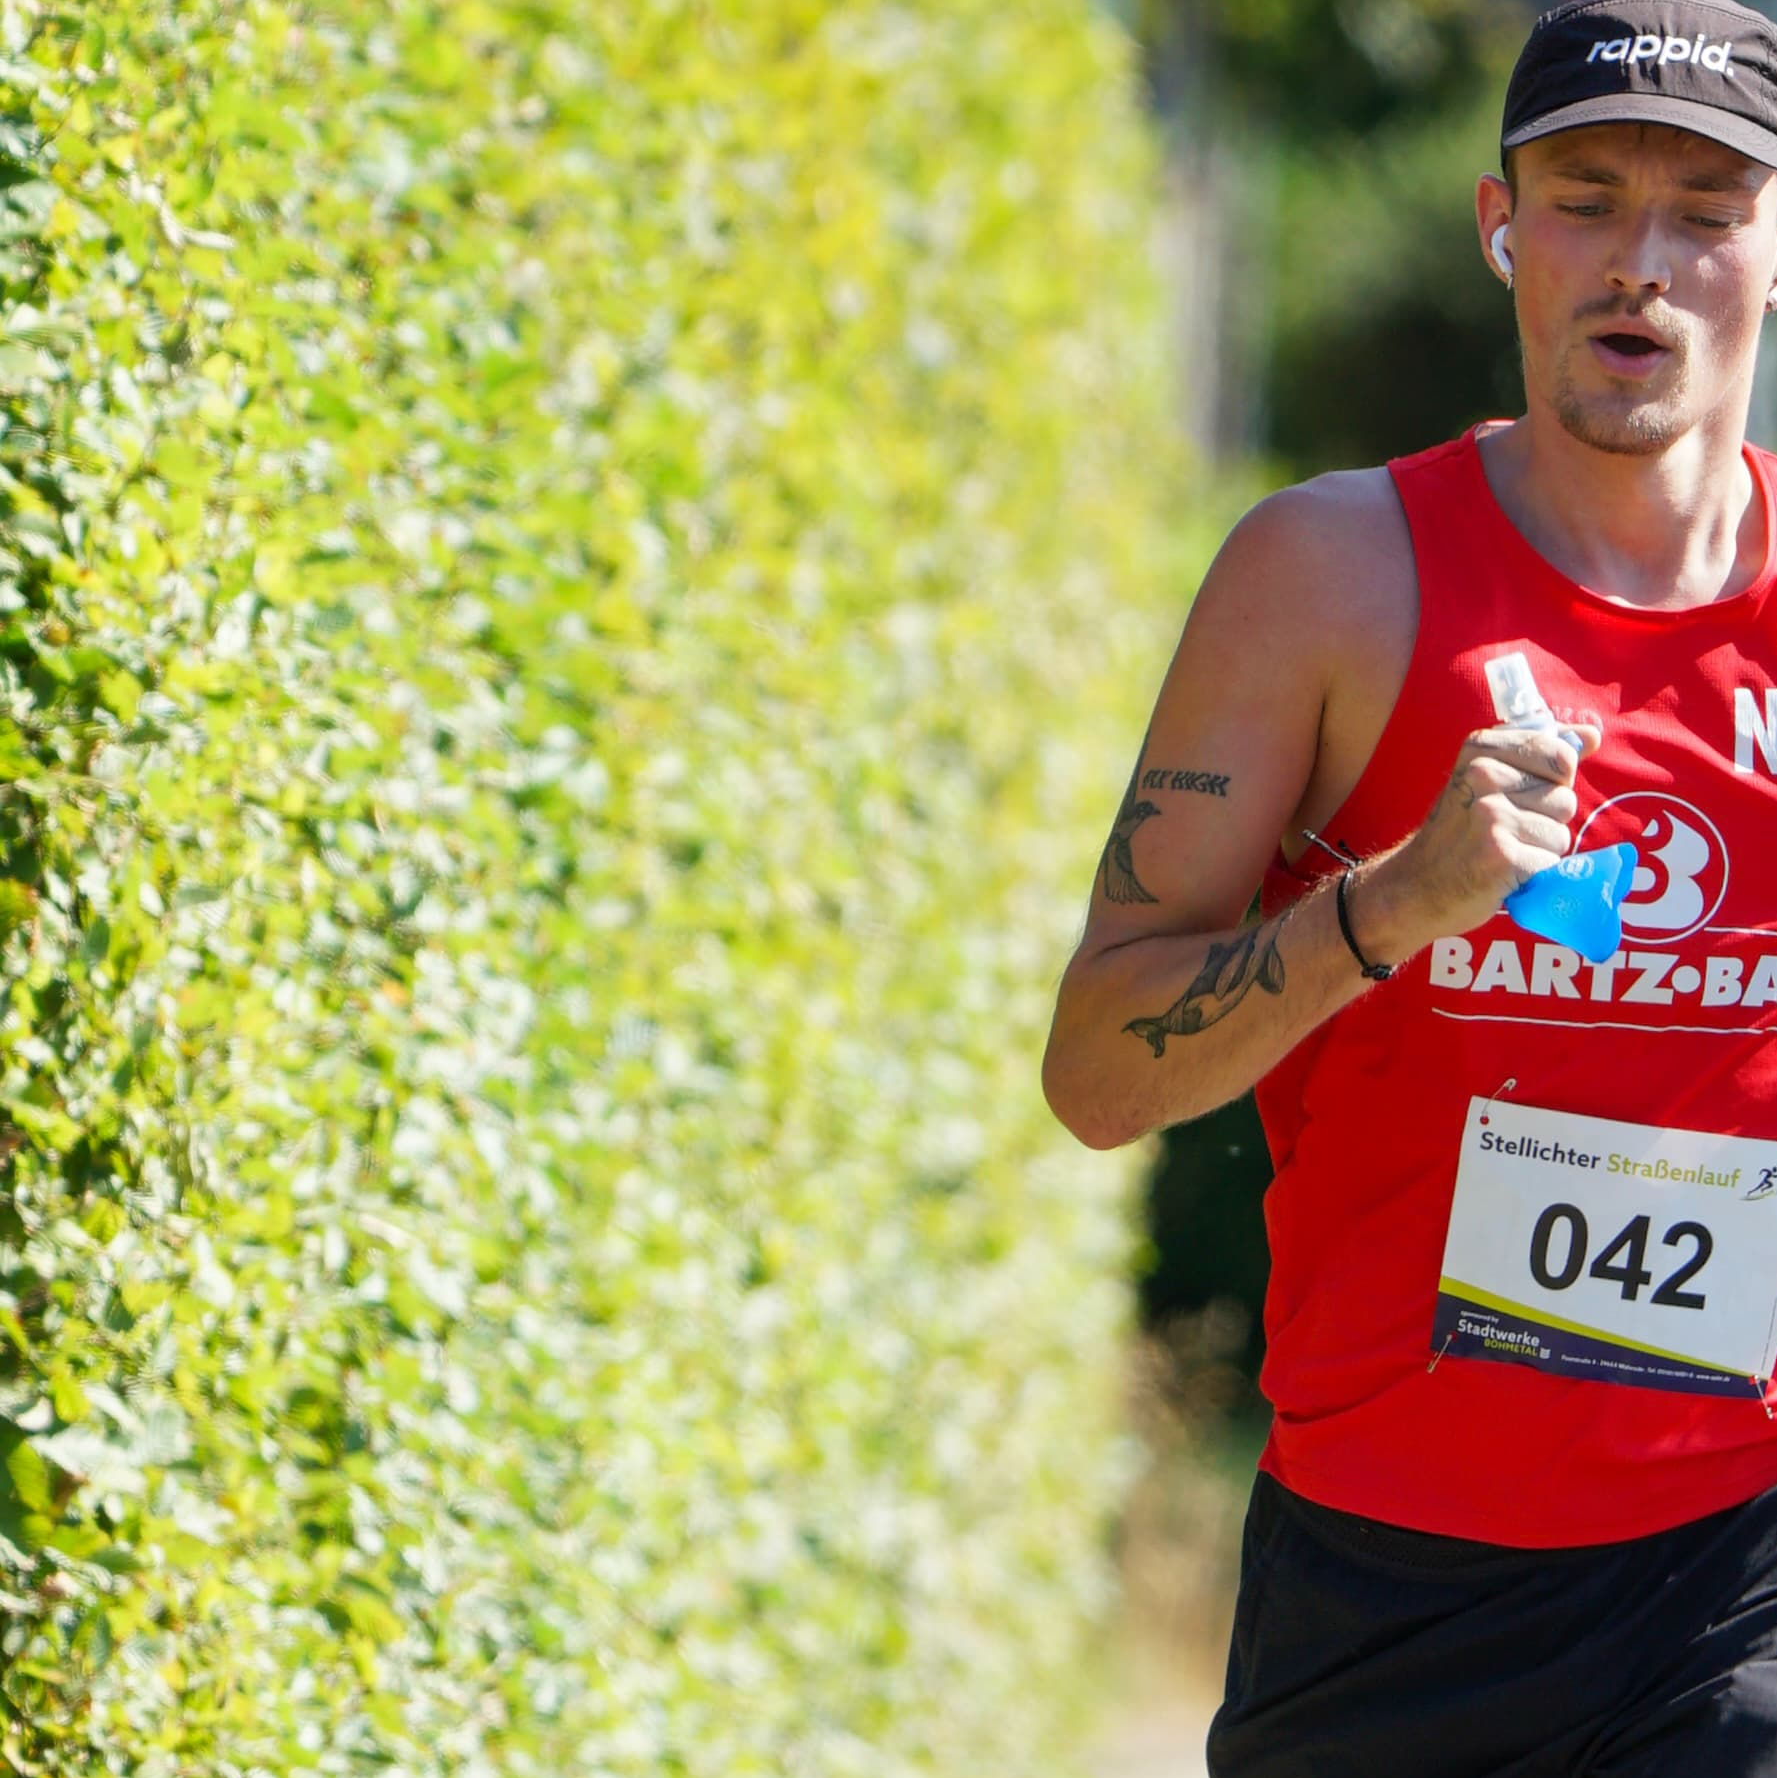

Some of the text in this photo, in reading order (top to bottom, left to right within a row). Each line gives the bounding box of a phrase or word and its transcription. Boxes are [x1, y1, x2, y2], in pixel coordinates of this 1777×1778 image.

[1586, 34, 1735, 77] rappid.
[1171, 770, 1231, 797] HIGH
[1480, 1131, 1742, 1189] Stellichter Straßenlauf
[1529, 1201, 1714, 1311] 042
[1457, 1319, 1541, 1347] Stadtwerke
